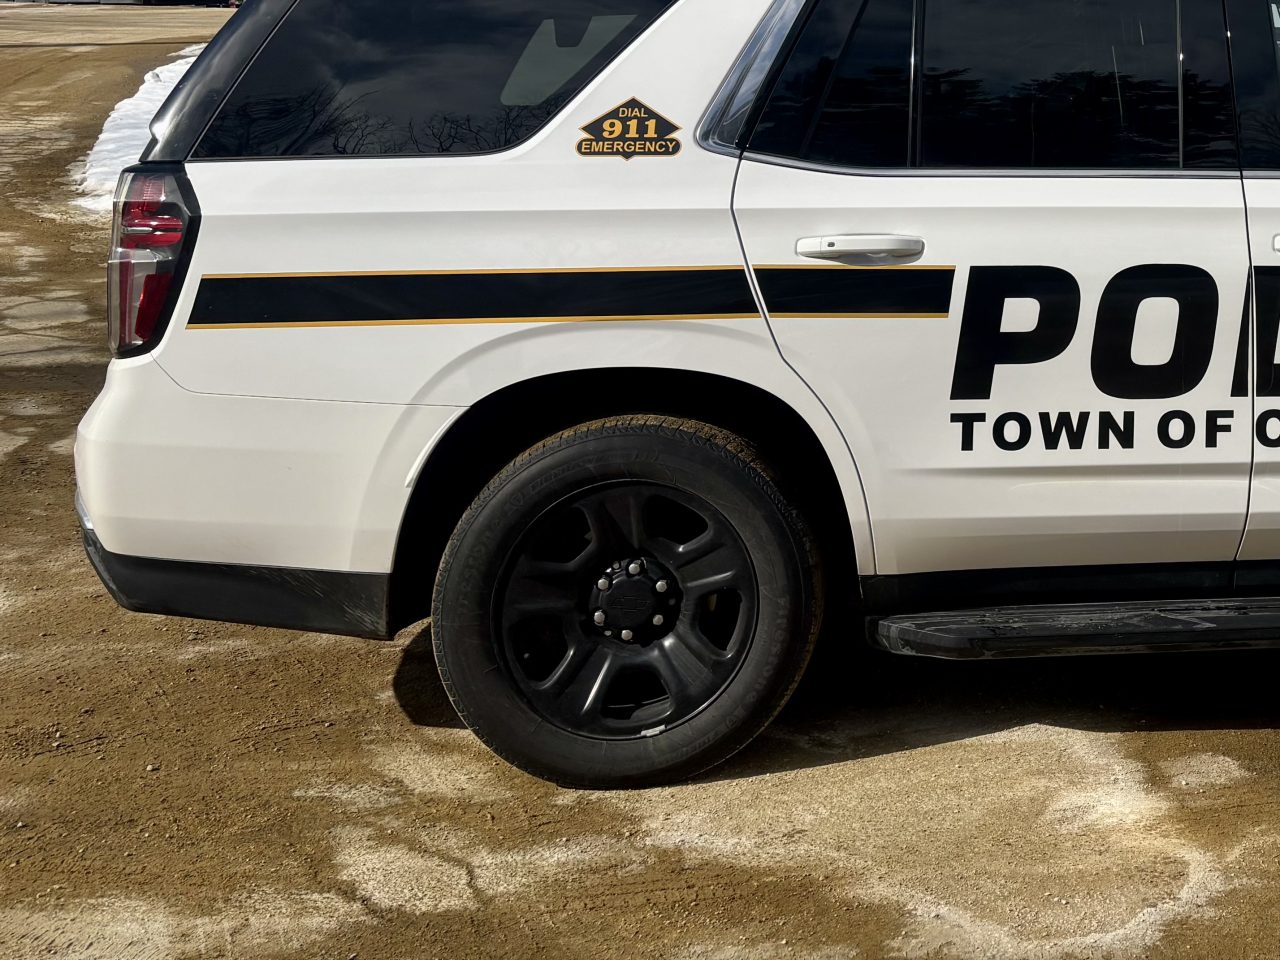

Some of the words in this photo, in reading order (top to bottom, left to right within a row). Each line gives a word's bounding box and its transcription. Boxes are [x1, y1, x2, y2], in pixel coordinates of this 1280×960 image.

[618, 107, 649, 117] DIAL
[602, 118, 658, 139] 911
[581, 141, 677, 153] EMERGENCY
[950, 409, 1136, 452] TOWN
[1157, 409, 1234, 450] OF
